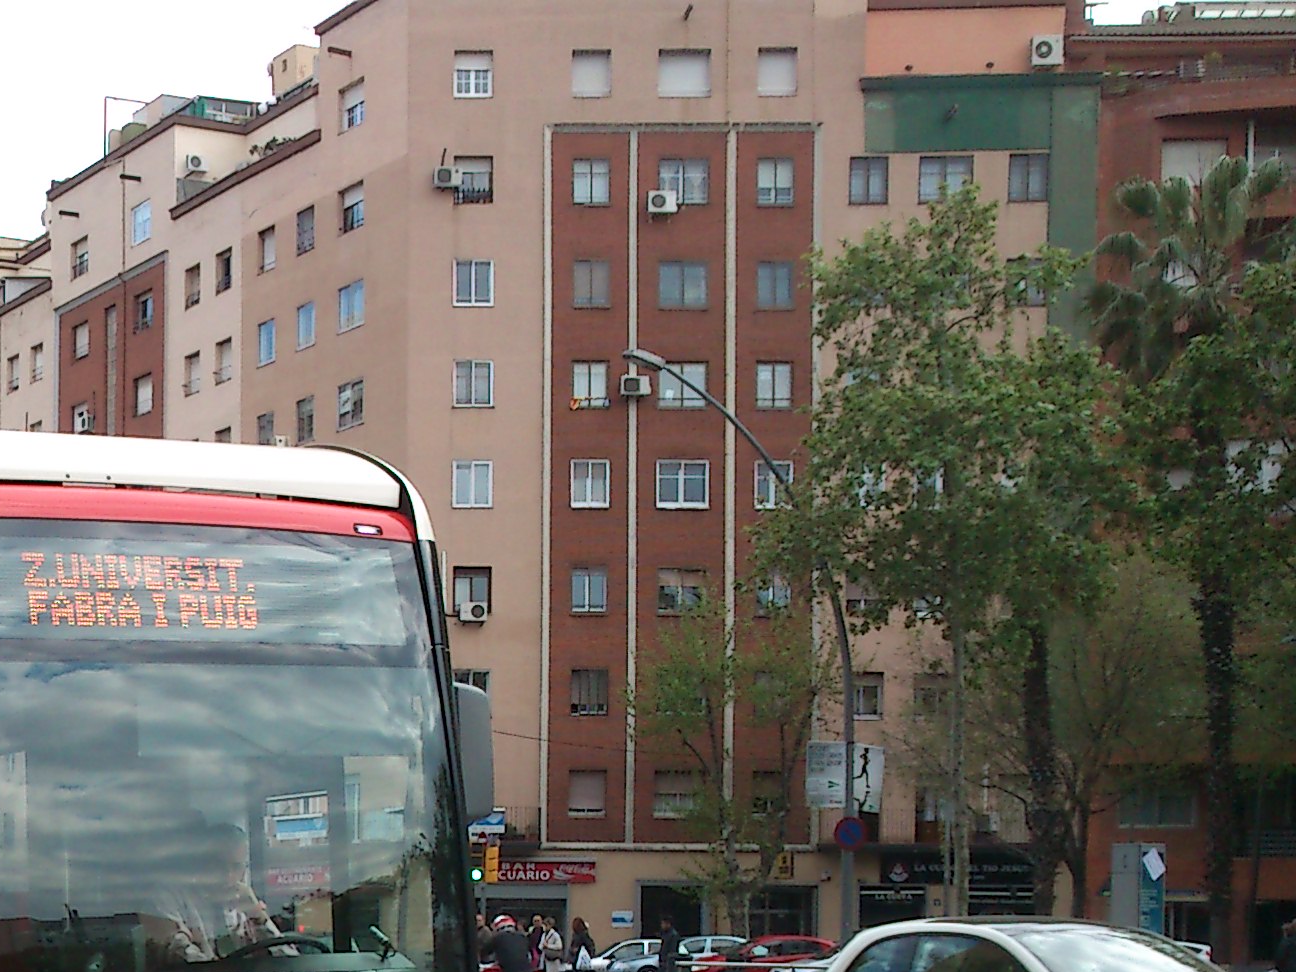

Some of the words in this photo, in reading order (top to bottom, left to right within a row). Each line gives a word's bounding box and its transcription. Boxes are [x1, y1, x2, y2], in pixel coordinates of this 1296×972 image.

[21, 552, 255, 593] Z.UNIVERSIT.
[28, 590, 141, 628] FABRA
[152, 593, 169, 628] I
[179, 594, 258, 630] PUIG
[497, 870, 551, 881] CUARIO
